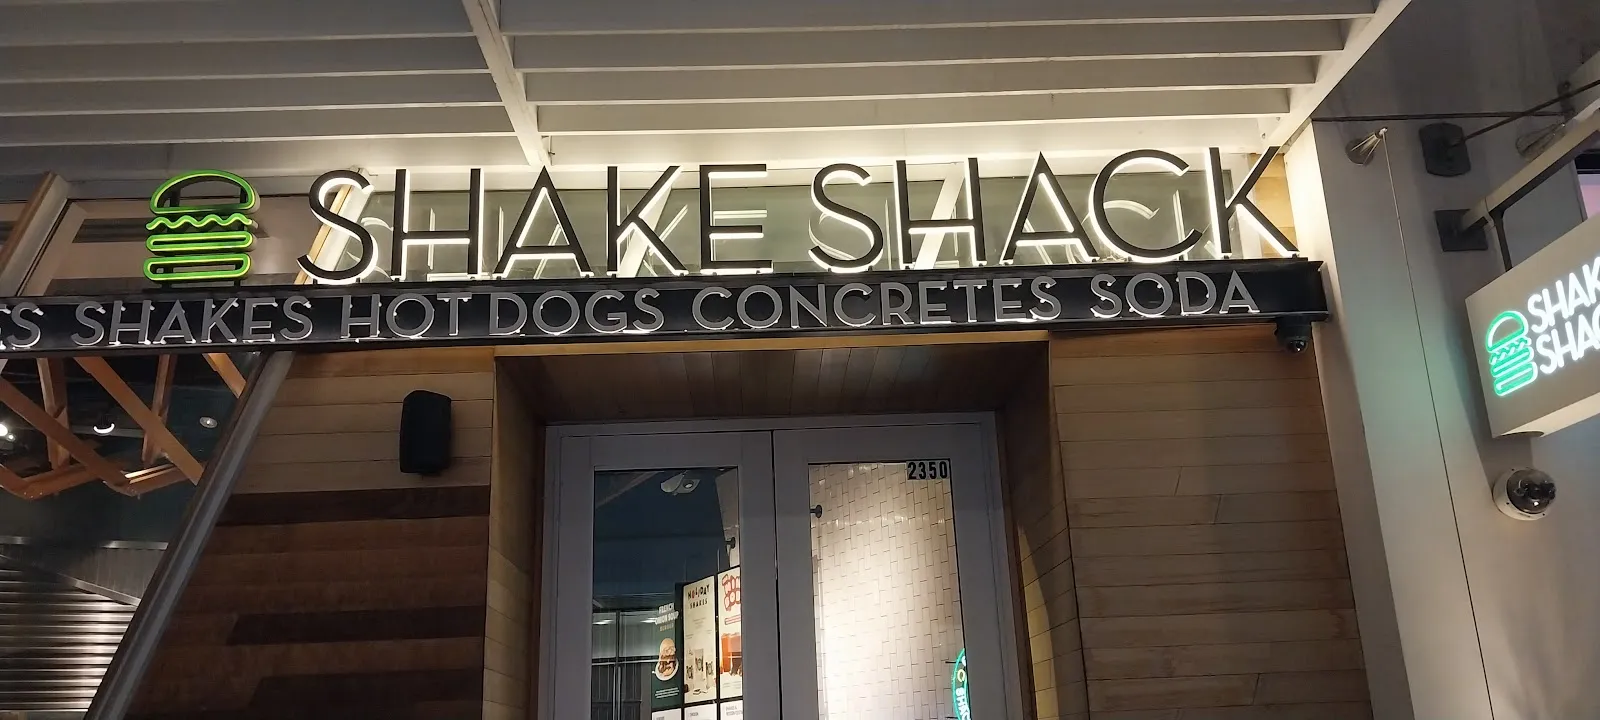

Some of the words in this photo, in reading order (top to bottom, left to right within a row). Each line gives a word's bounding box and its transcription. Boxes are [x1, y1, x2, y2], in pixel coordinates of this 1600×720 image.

[297, 165, 773, 284] SHAKE
[808, 145, 1299, 273] SHACK
[71, 295, 313, 346] SHAKES
[340, 290, 472, 340] HOT
[489, 287, 664, 336] DOGS
[691, 275, 1062, 331] CONCRETES
[1090, 270, 1260, 319] SODA
[907, 460, 948, 480] 2350
[687, 584, 710, 601] HOLIDAY
